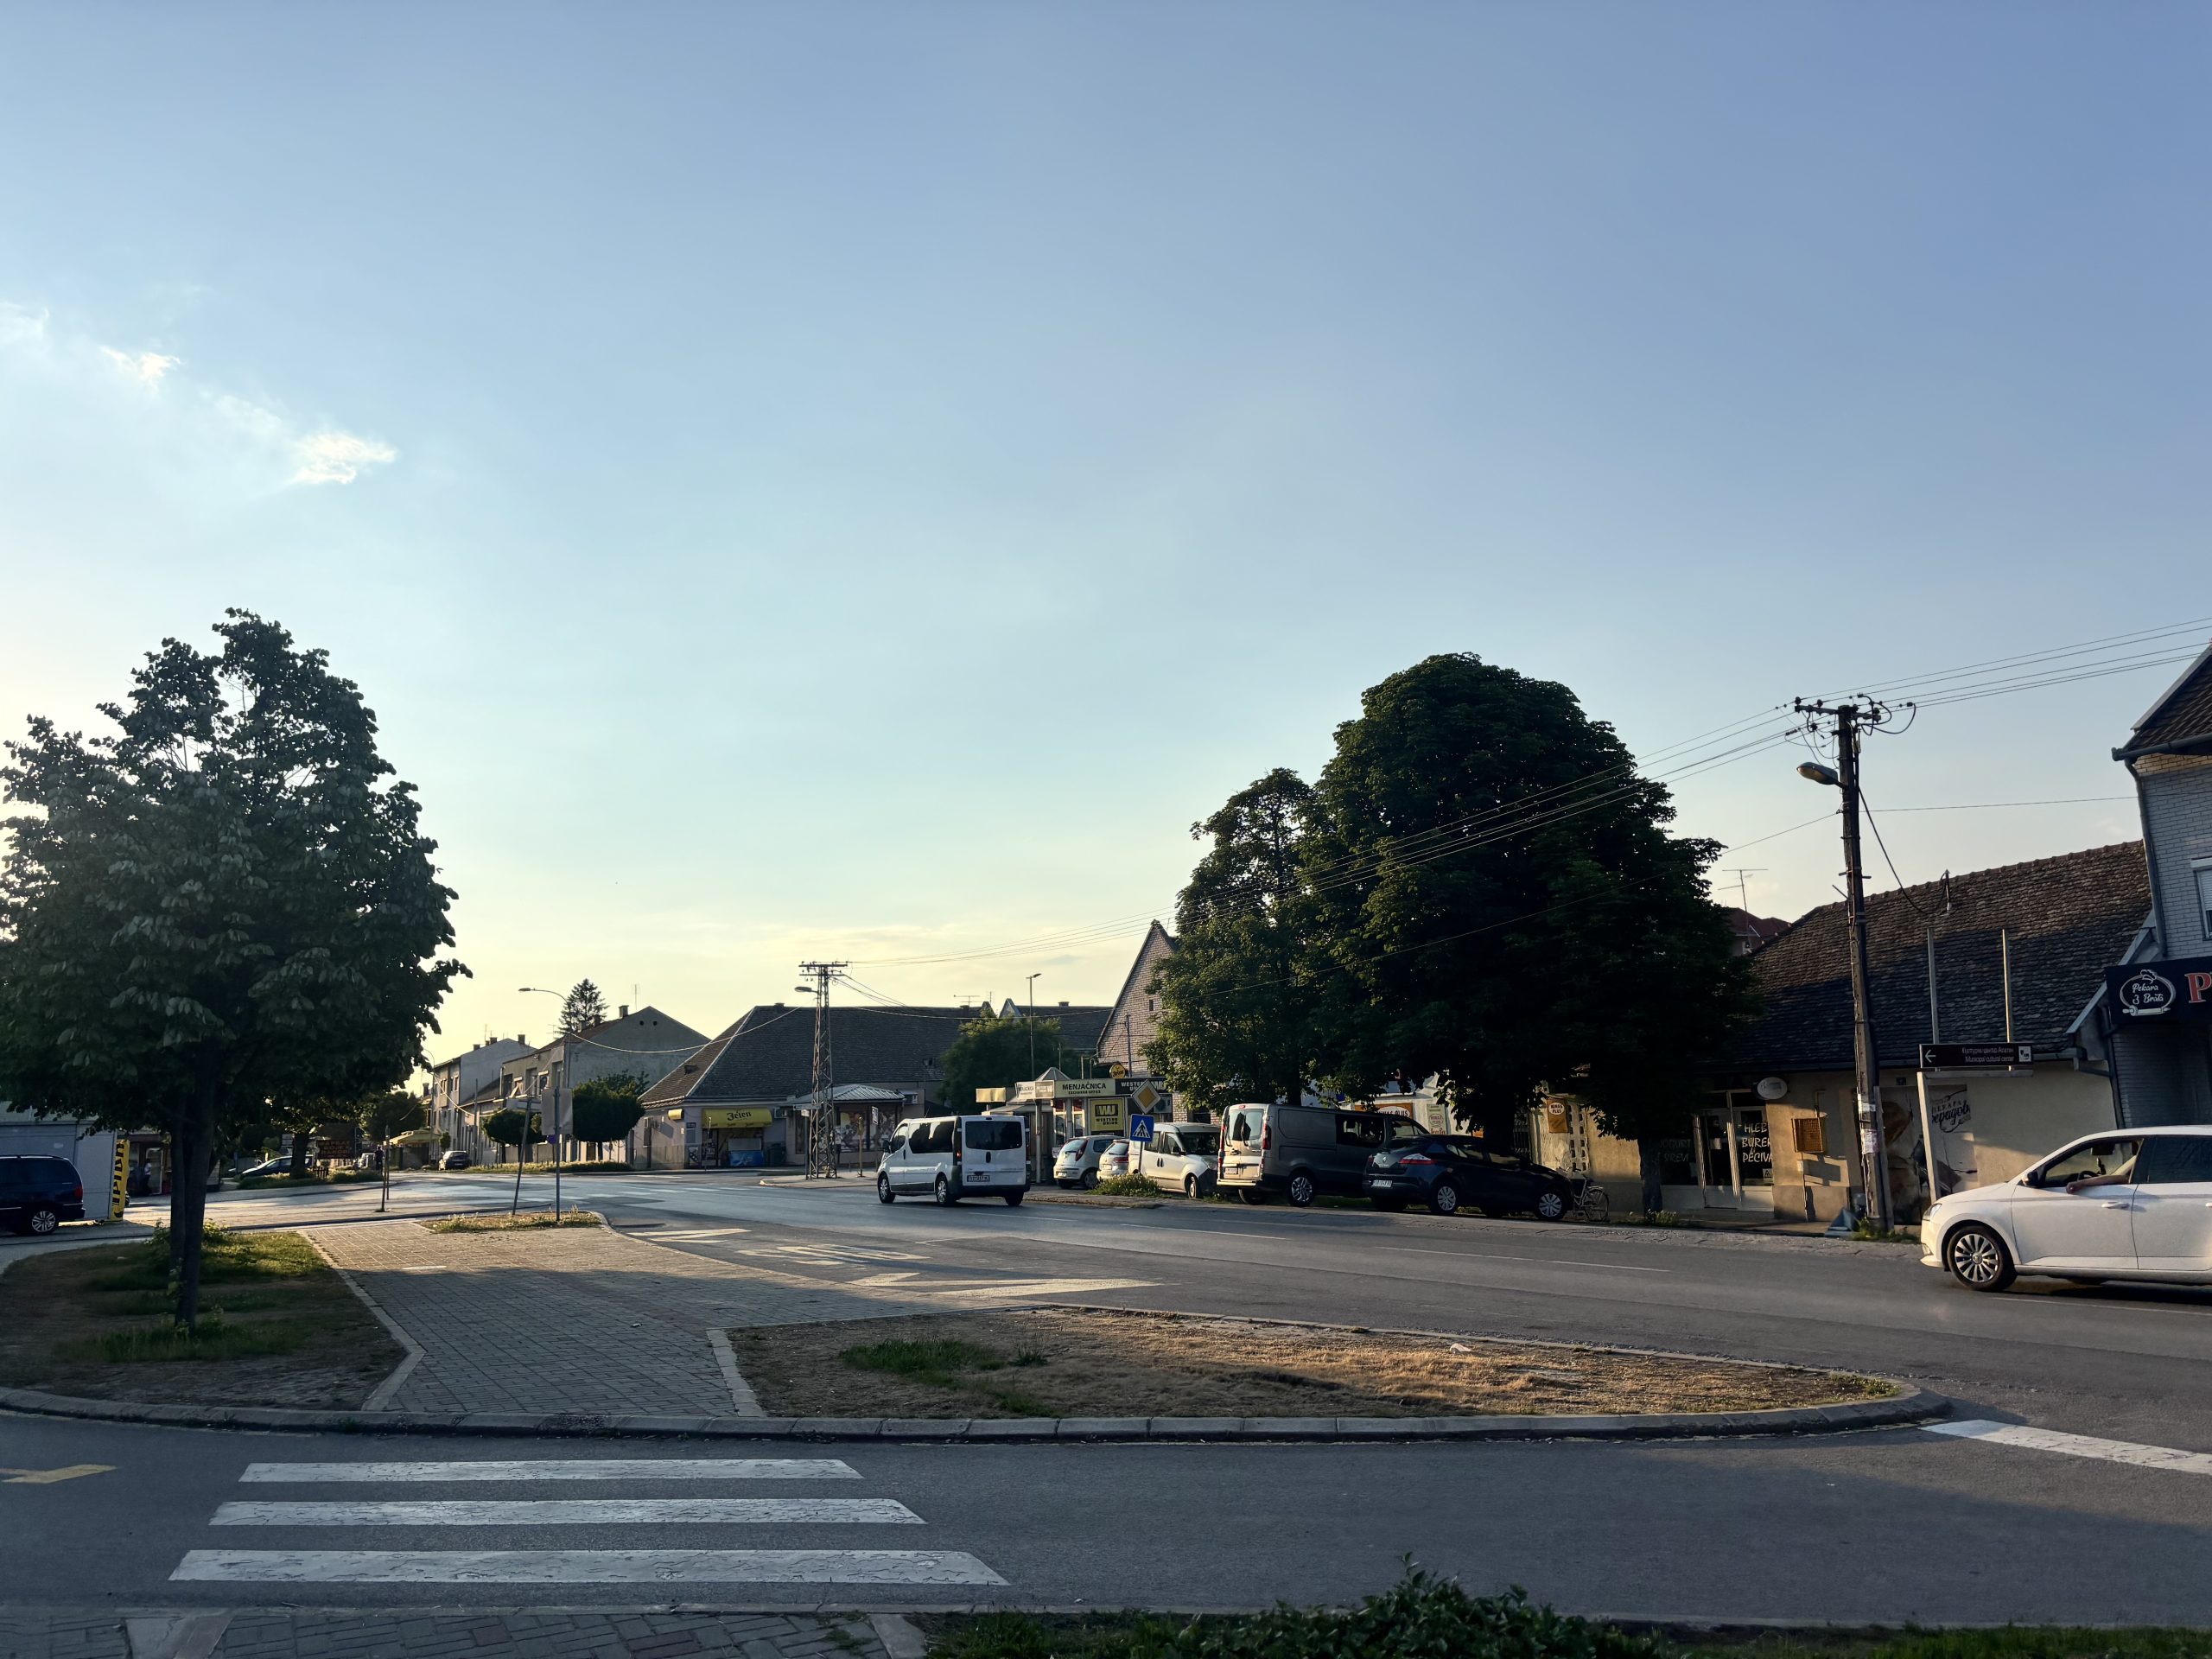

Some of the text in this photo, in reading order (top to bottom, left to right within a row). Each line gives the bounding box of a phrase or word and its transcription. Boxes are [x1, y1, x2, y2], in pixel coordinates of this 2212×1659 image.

[2133, 983, 2158, 993] Pekara
[2133, 993, 2164, 1005] 3 Brata
[1062, 1081, 1106, 1090] MENJAČNICA
[1745, 1122, 1767, 1134] HLEB
